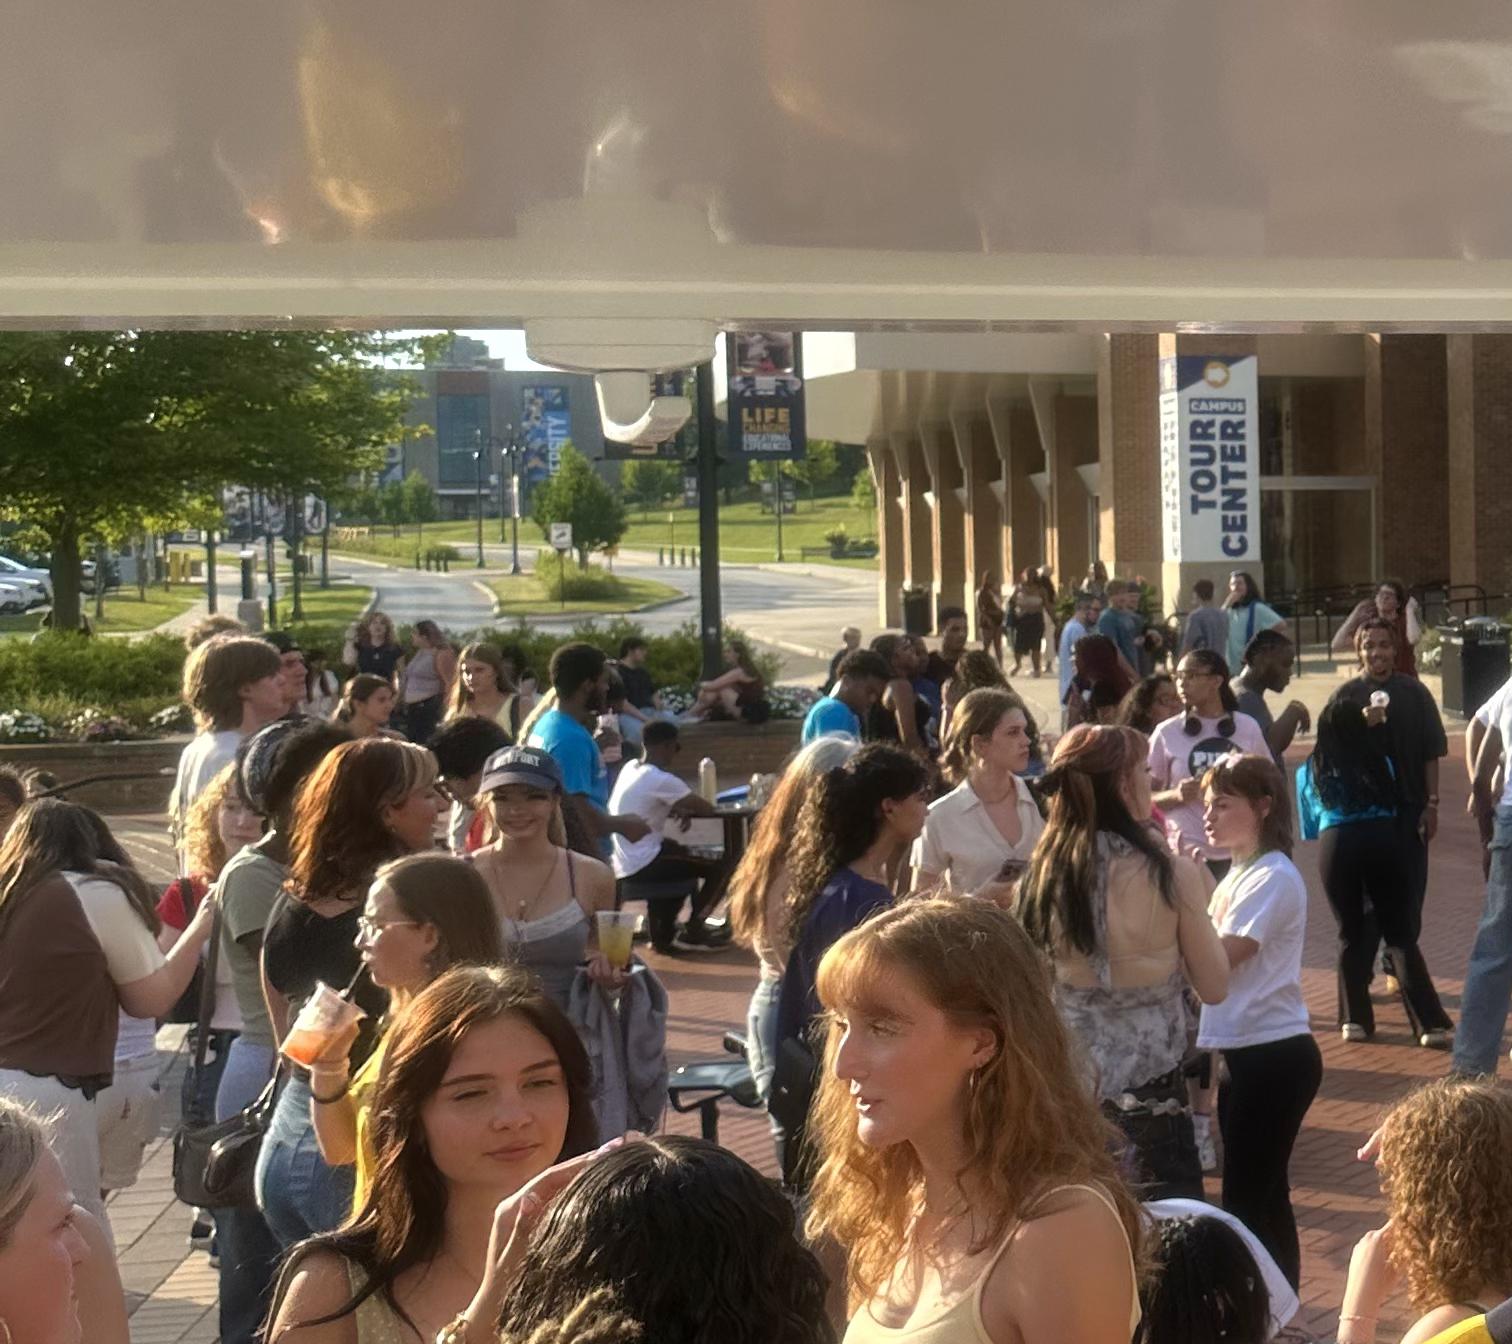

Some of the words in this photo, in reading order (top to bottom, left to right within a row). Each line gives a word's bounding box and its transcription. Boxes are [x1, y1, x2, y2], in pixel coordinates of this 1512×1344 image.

[742, 407, 790, 423] LIFE
[1190, 399, 1245, 413] CAMPUS
[1190, 419, 1217, 515] TOUR
[1220, 419, 1249, 558] CENTER
